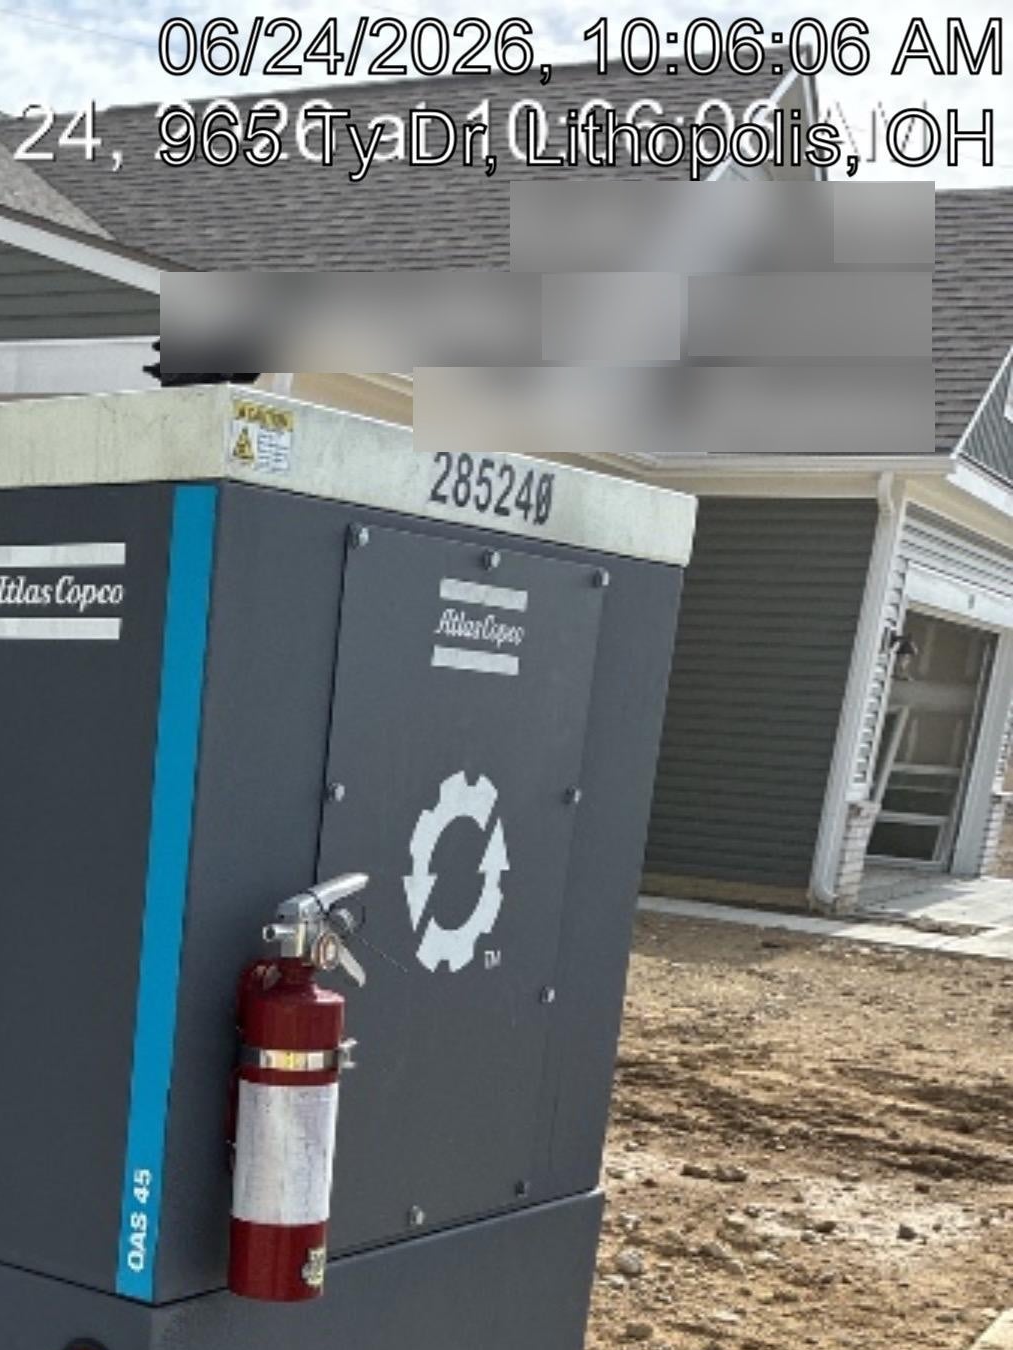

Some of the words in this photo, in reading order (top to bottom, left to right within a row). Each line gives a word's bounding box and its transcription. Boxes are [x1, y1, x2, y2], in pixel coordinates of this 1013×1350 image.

[428, 450, 555, 526] 285240
[54, 574, 125, 614] Copco
[434, 607, 483, 641] Atlas
[132, 1168, 153, 1204] 45
